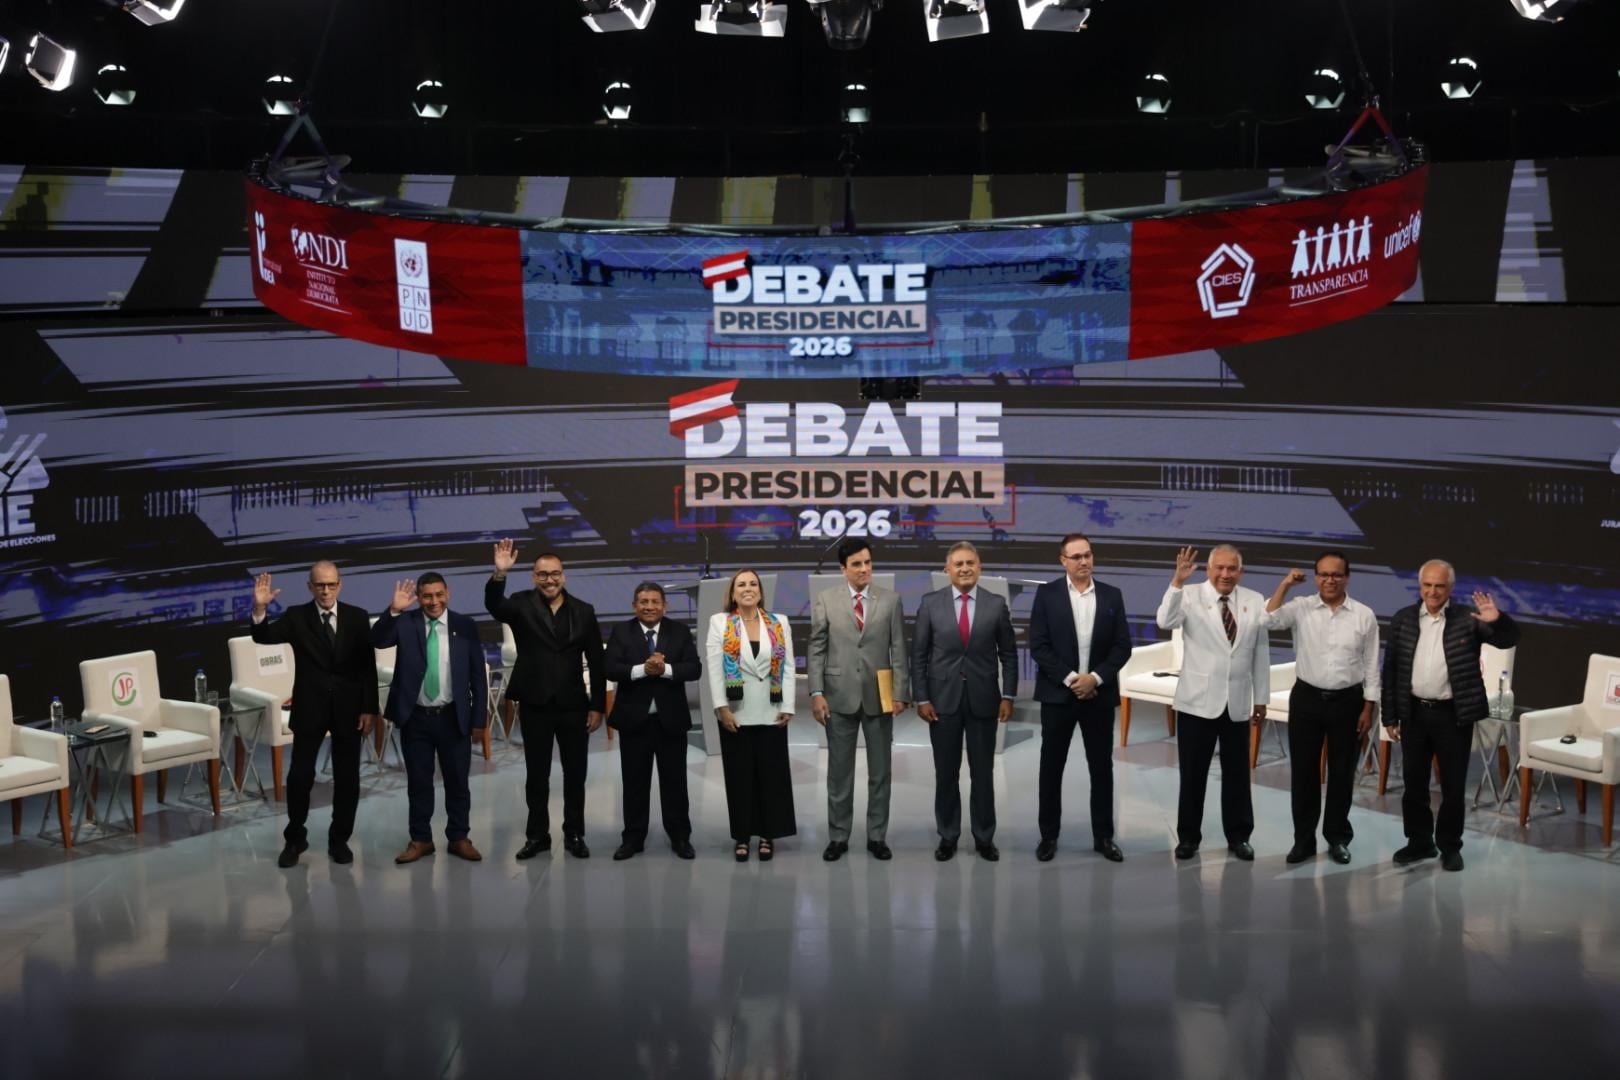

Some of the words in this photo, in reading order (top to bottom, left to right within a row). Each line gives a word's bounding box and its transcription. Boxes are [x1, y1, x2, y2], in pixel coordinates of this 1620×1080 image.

[307, 231, 349, 270] NDI
[1384, 213, 1414, 259] unicef
[713, 263, 927, 304] DEBATE
[1212, 272, 1242, 287] CIES
[1289, 268, 1369, 300] TRANSPARENCIA
[719, 310, 920, 331] PRESIDENCIAL
[789, 336, 852, 357] 2026
[685, 401, 1004, 459] DEBATE
[694, 469, 996, 501] PRESIDENCIAL
[799, 509, 892, 538] 2026
[260, 654, 283, 667] OBRAS
